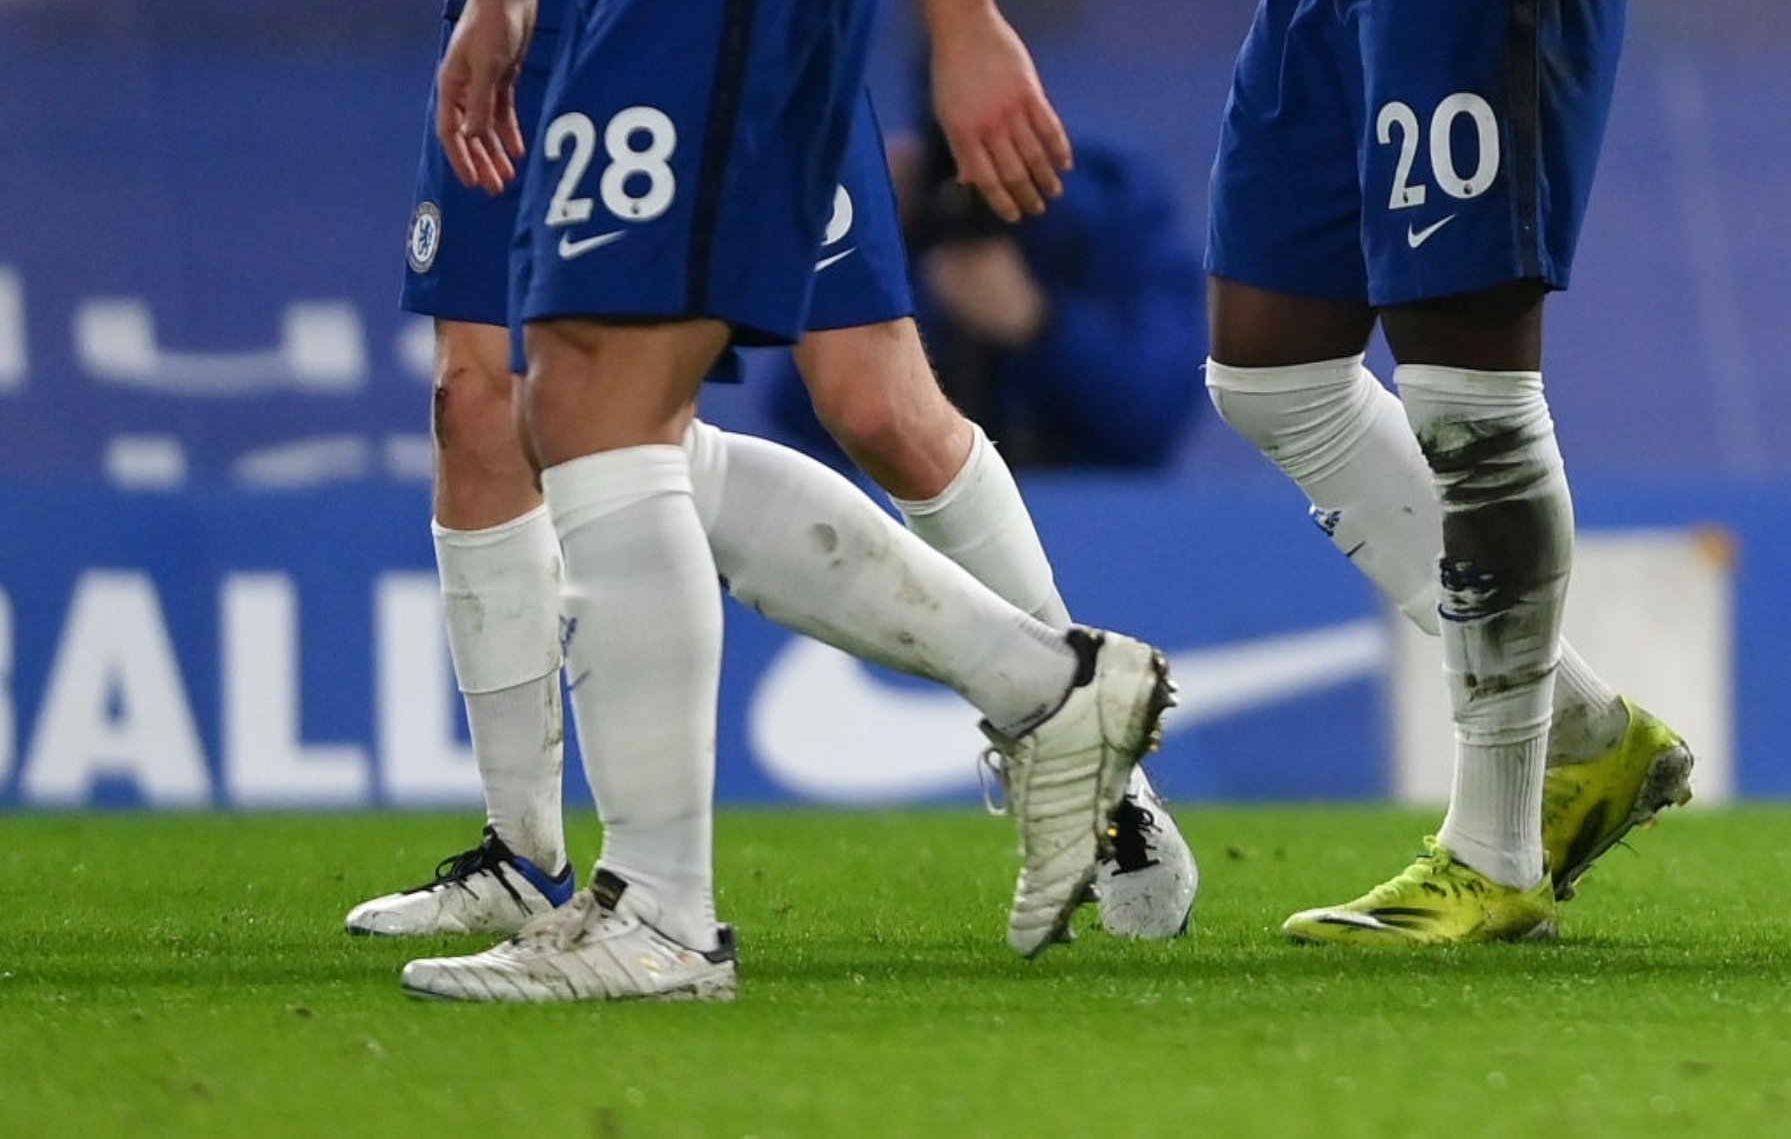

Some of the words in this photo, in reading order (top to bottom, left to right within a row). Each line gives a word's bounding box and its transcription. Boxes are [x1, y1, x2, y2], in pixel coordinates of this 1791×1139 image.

[544, 106, 677, 226] 28
[1376, 92, 1500, 210] 20
[0, 570, 482, 804] ALL
